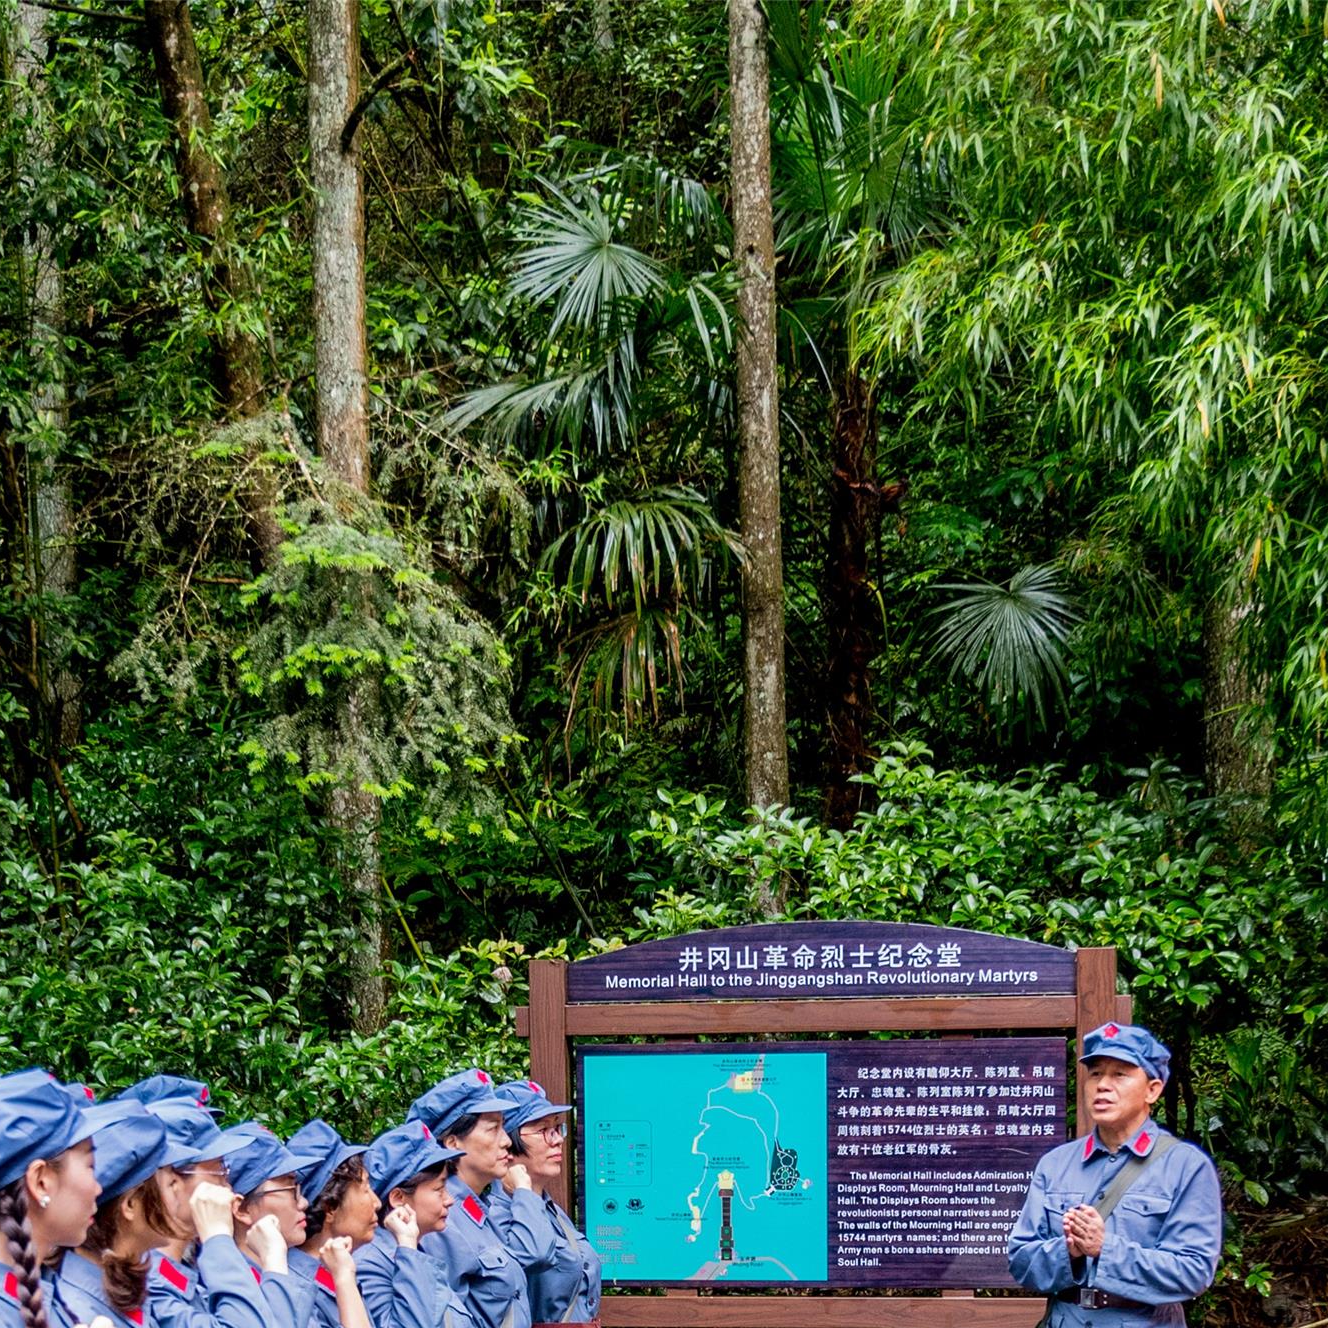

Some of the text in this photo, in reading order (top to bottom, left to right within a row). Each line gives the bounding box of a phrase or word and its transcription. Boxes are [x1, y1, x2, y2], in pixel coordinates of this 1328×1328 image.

[678, 941, 963, 971] 井冈山革命烈士纪念堂
[605, 968, 1039, 989] Memorial Hall to the Jinggangshan Revolutionary Martyrs
[850, 1171, 868, 1180] The
[869, 1171, 912, 1180] Memorial
[913, 1171, 932, 1180] Hall
[933, 1171, 972, 1180] includes
[973, 1171, 1024, 1180] Admiration
[837, 1184, 1028, 1194] Displays Room, Mourning Hall and Loyalty
[837, 1196, 996, 1206] Hall. The Displays Room shows the
[901, 1209, 942, 1218] personal
[943, 1209, 990, 1217] narratives
[991, 1209, 1009, 1217] and
[837, 1221, 856, 1230] The
[857, 1221, 880, 1230] walls
[882, 1221, 892, 1230] of
[893, 1221, 908, 1230] the
[909, 1221, 952, 1231] Mourning
[954, 1221, 973, 1230] Hall
[975, 1222, 990, 1230] are
[837, 1233, 866, 1242] 15744
[942, 1233, 959, 1242] and
[961, 1233, 985, 1242] there
[987, 1234, 1003, 1242] are
[837, 1246, 861, 1255] Army
[891, 1246, 914, 1254] bone
[916, 1246, 943, 1254] ashes
[945, 1246, 990, 1255] emplaced
[992, 1246, 1000, 1254] in
[837, 1258, 882, 1266] Soul Hall.
